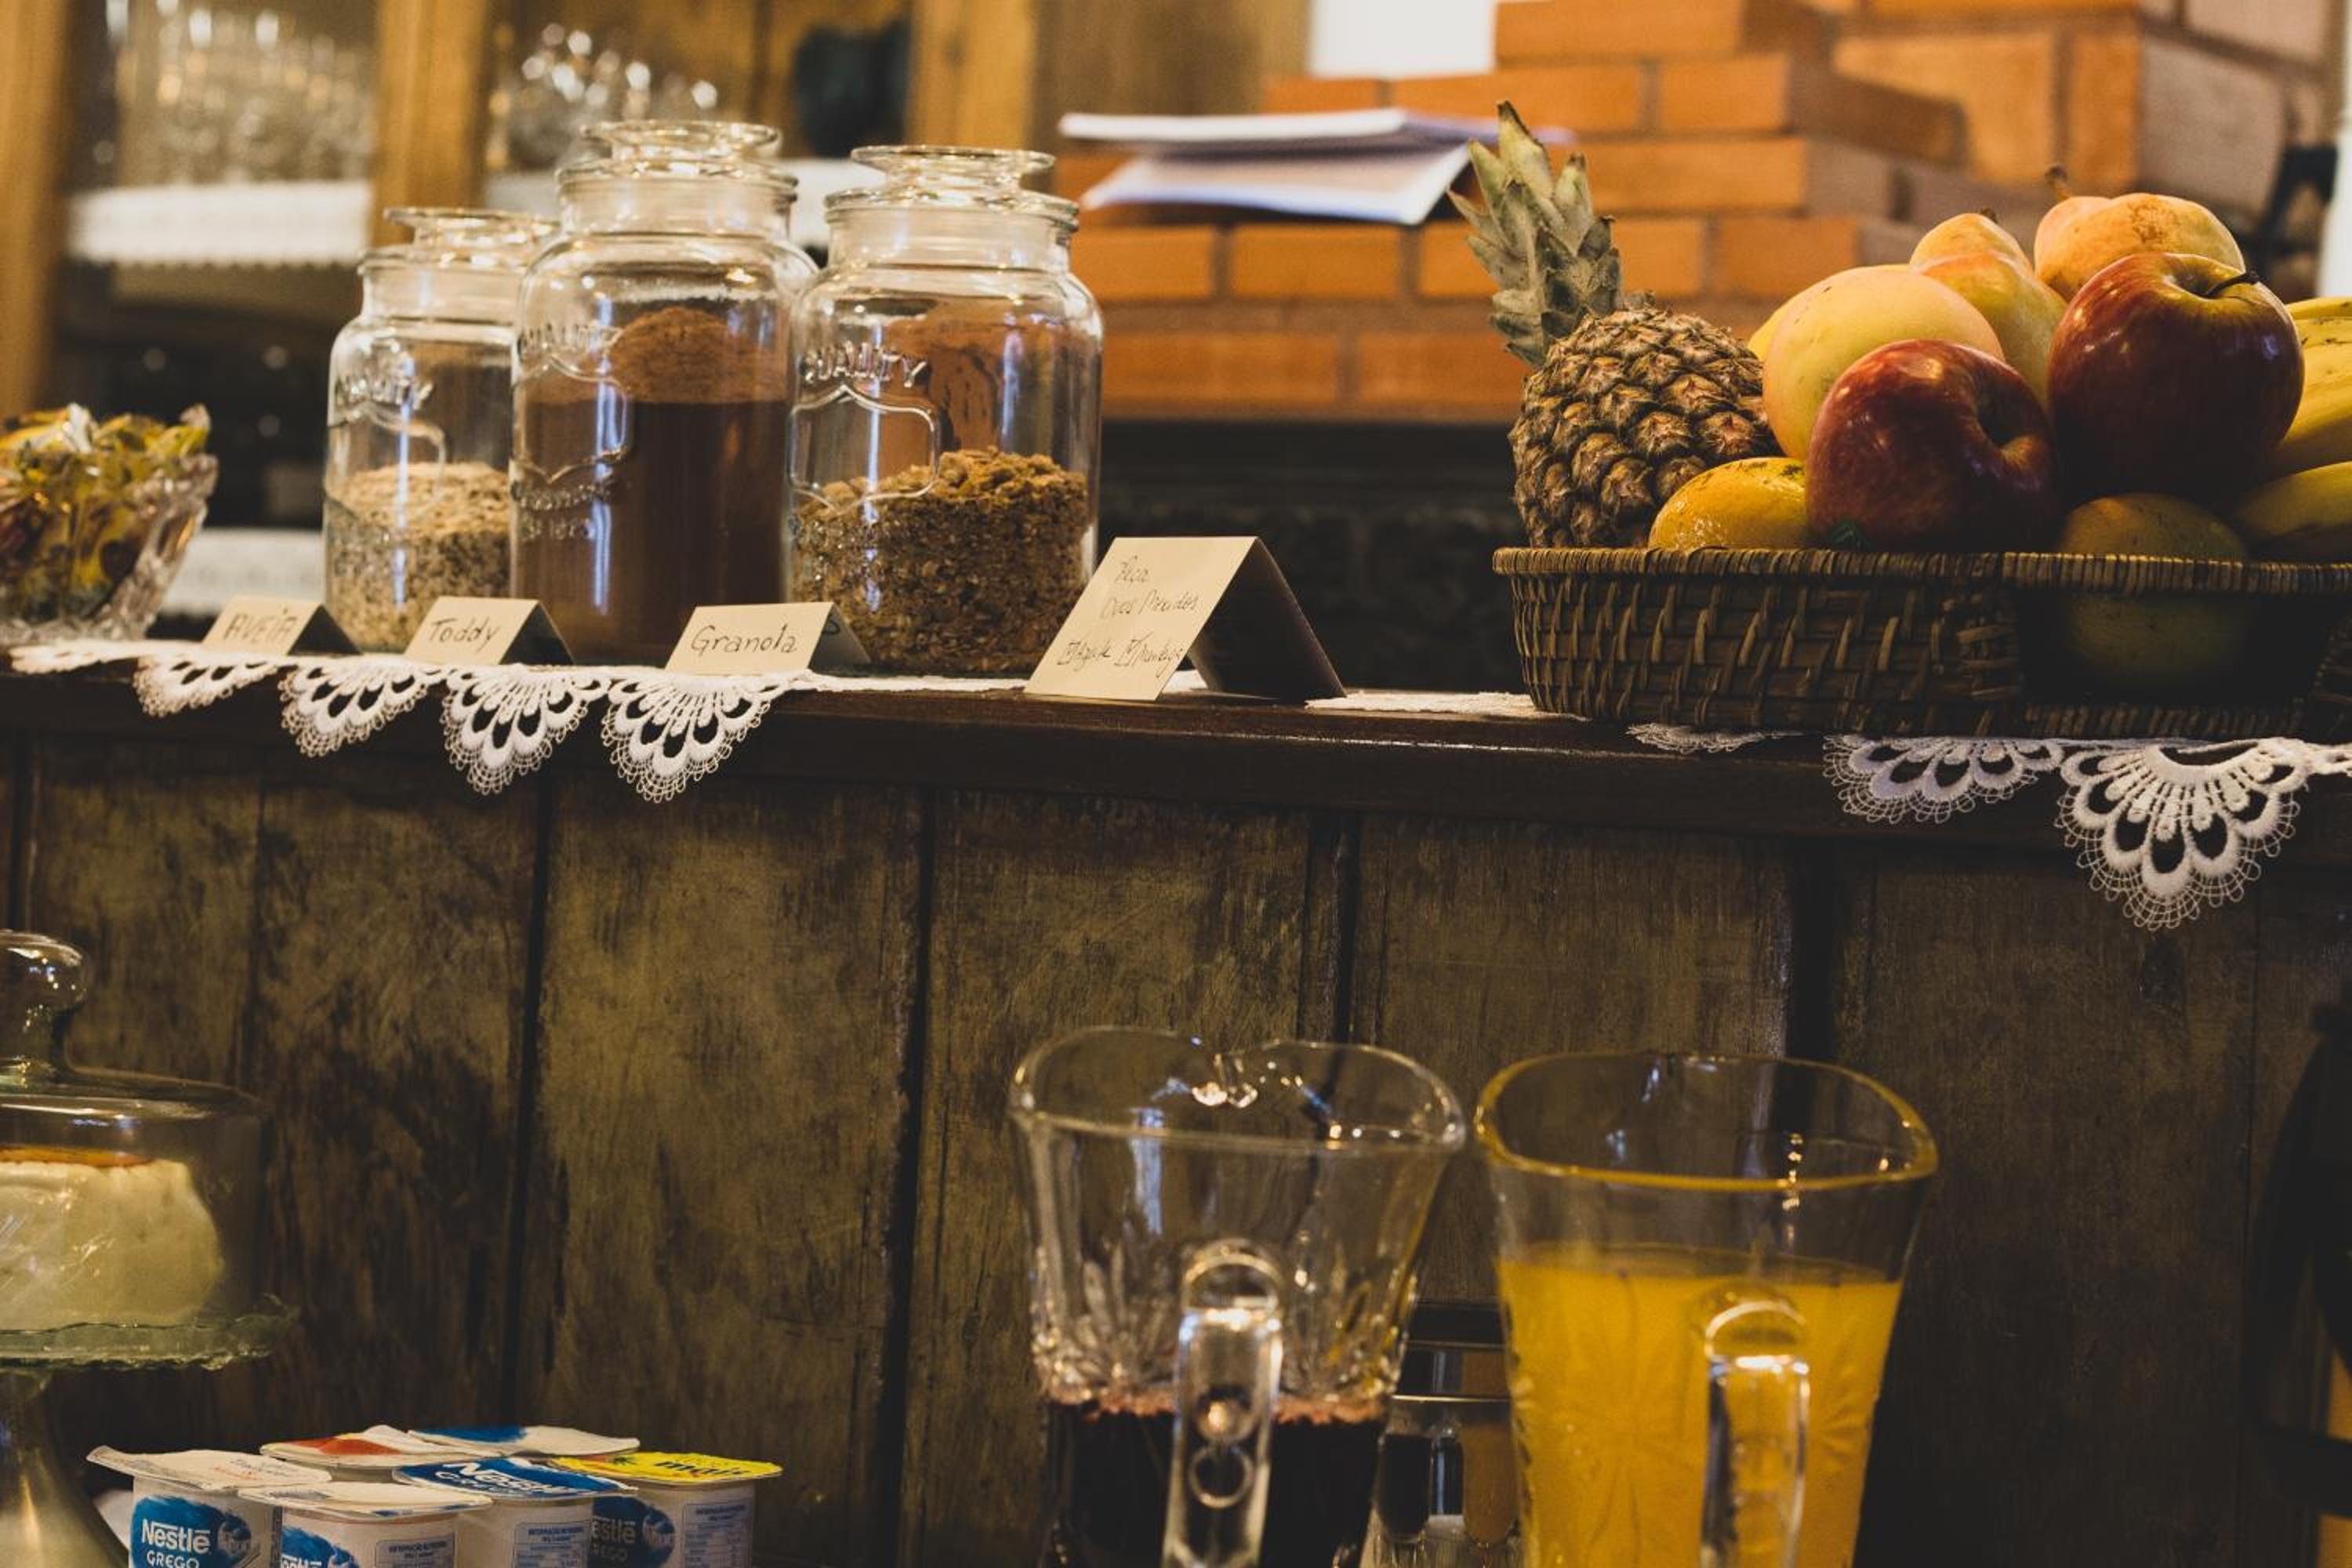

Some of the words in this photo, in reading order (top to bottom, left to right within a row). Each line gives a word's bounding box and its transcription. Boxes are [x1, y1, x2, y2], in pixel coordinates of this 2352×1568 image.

[429, 616, 502, 652] Toddy
[691, 624, 797, 657] Granola
[142, 1519, 211, 1555] Nestlé
[147, 1550, 200, 1568] GREGO
